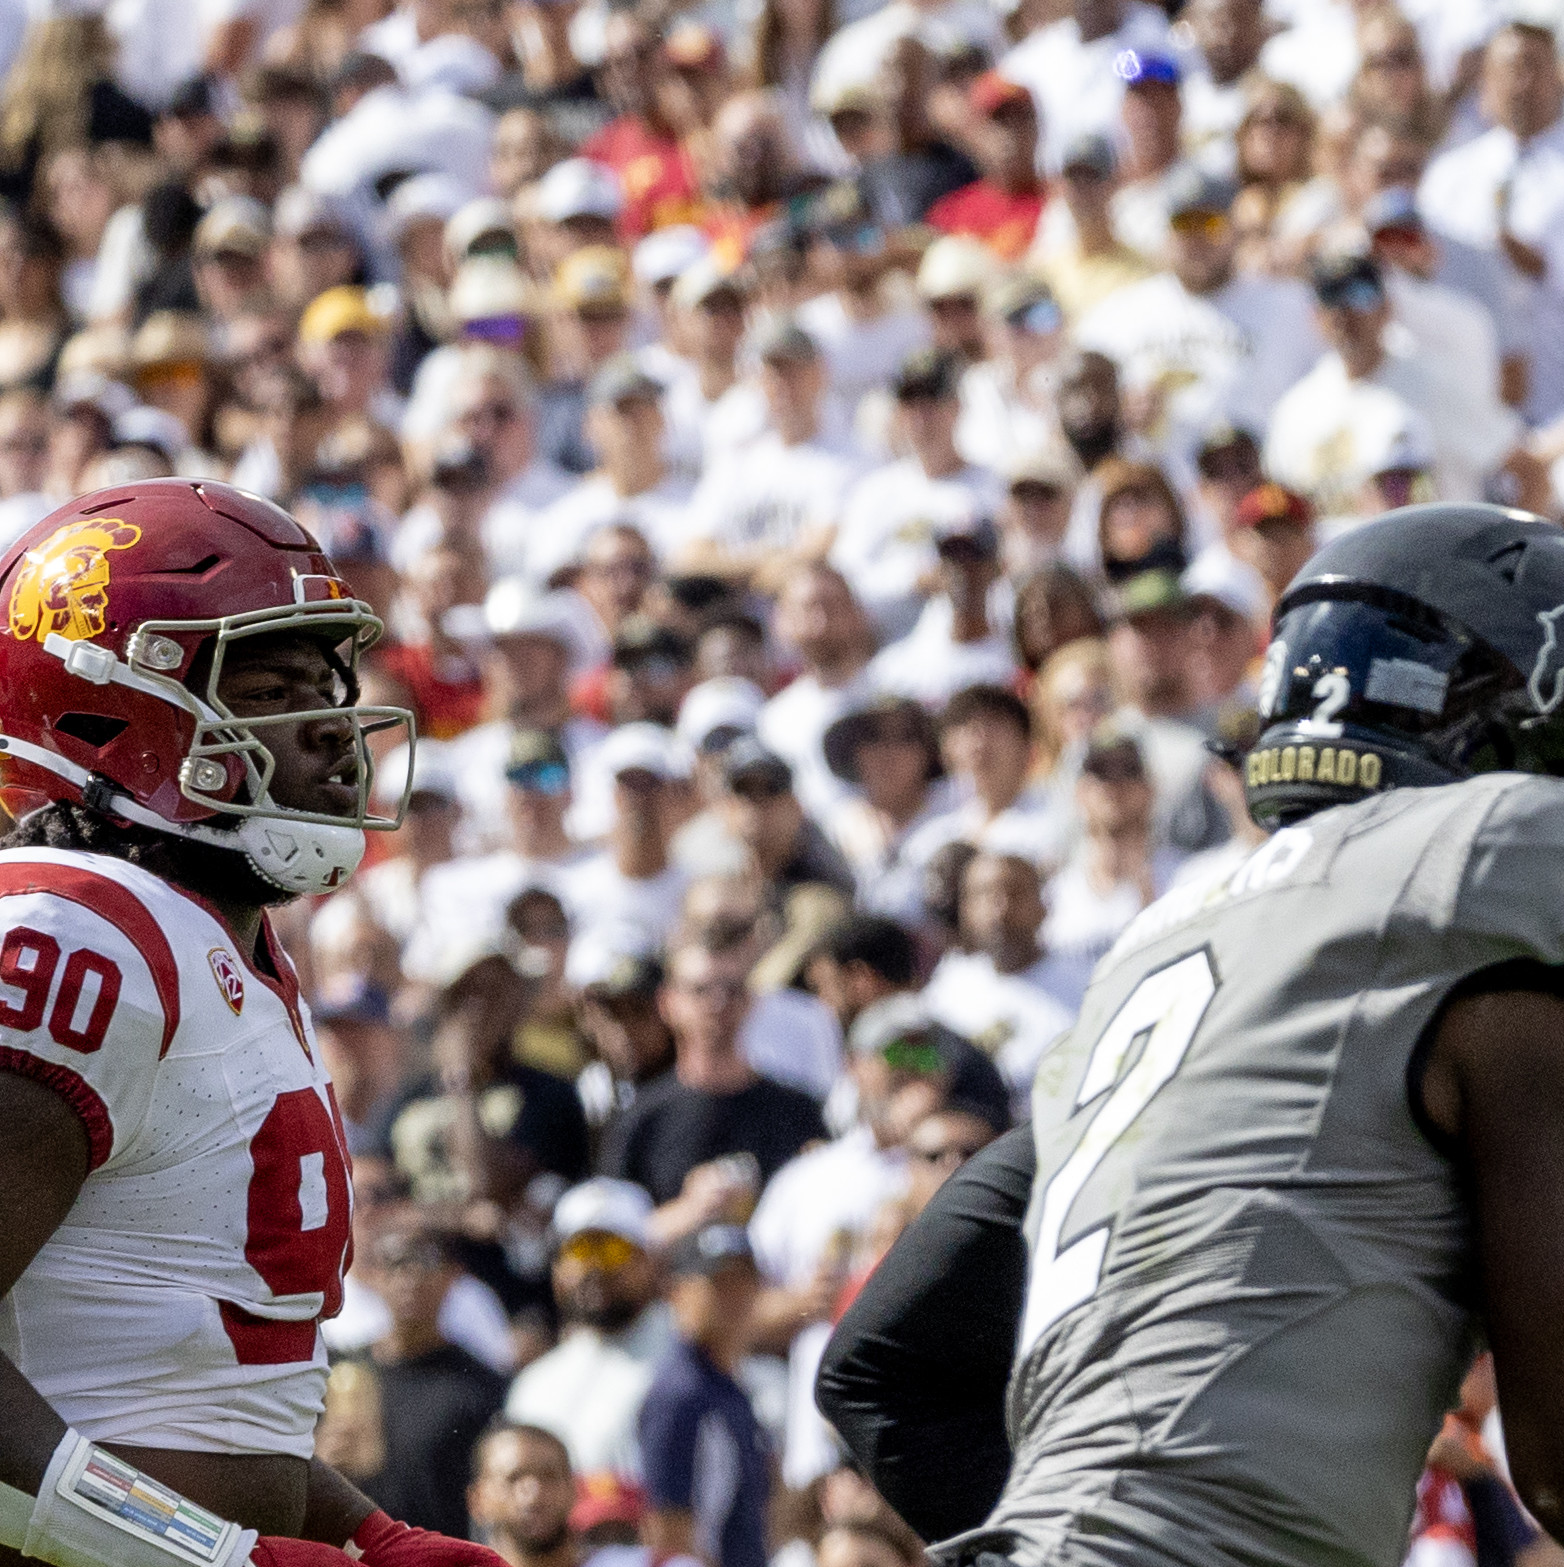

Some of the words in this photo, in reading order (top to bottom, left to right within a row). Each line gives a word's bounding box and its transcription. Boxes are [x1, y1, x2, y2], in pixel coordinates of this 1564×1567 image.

[1247, 745, 1382, 790] COLORADO
[1297, 672, 1351, 738] 2
[0, 925, 124, 1056] 90
[1017, 940, 1219, 1362] 2
[217, 1086, 354, 1367] 9
